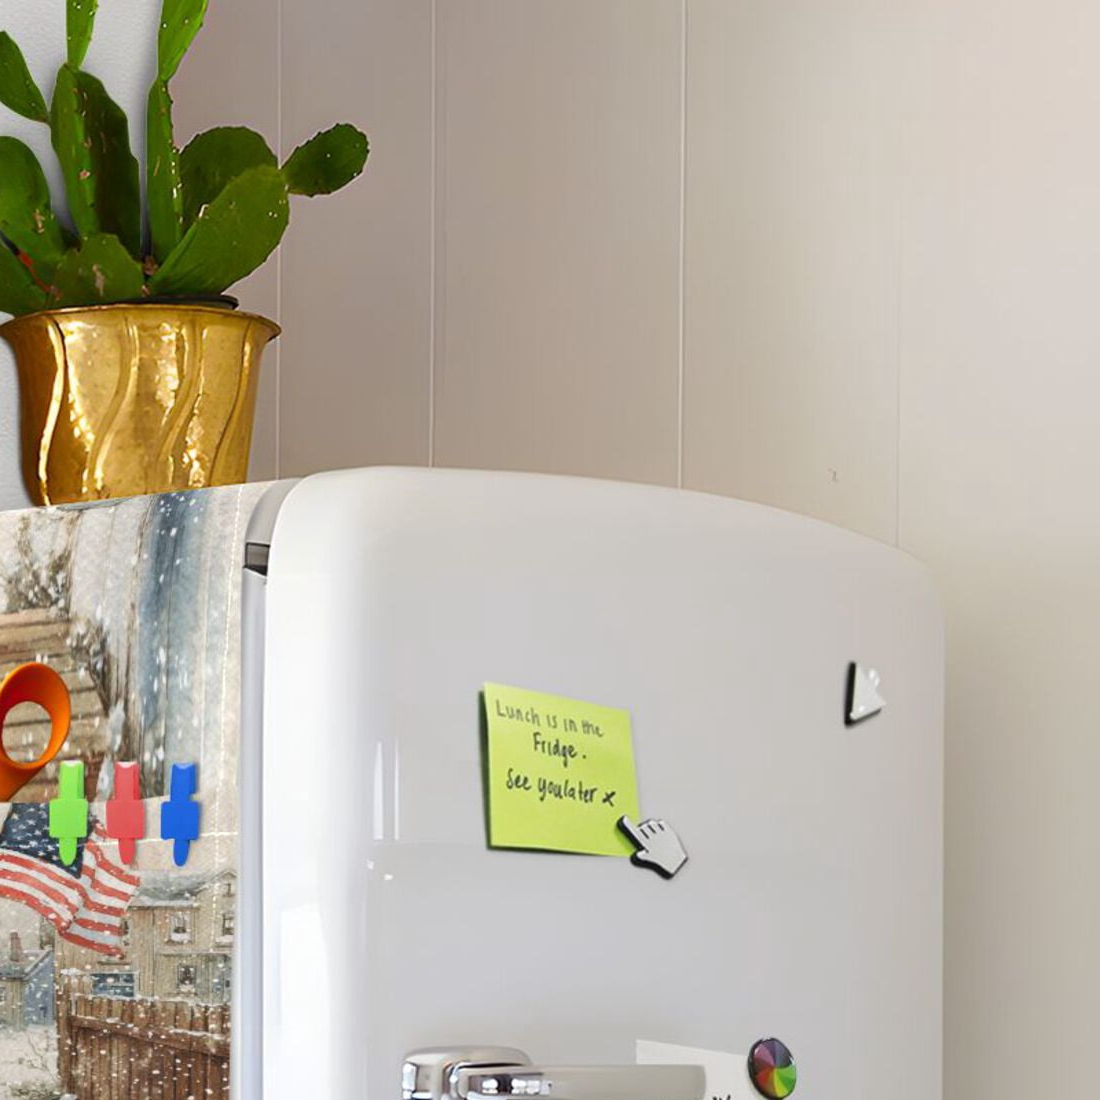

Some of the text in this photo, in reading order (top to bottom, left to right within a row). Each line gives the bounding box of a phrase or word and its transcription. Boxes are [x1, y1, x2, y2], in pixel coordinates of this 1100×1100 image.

[495, 699, 540, 728] Lunch
[563, 718, 578, 733] in
[581, 720, 604, 738] the
[506, 768, 532, 790] See
